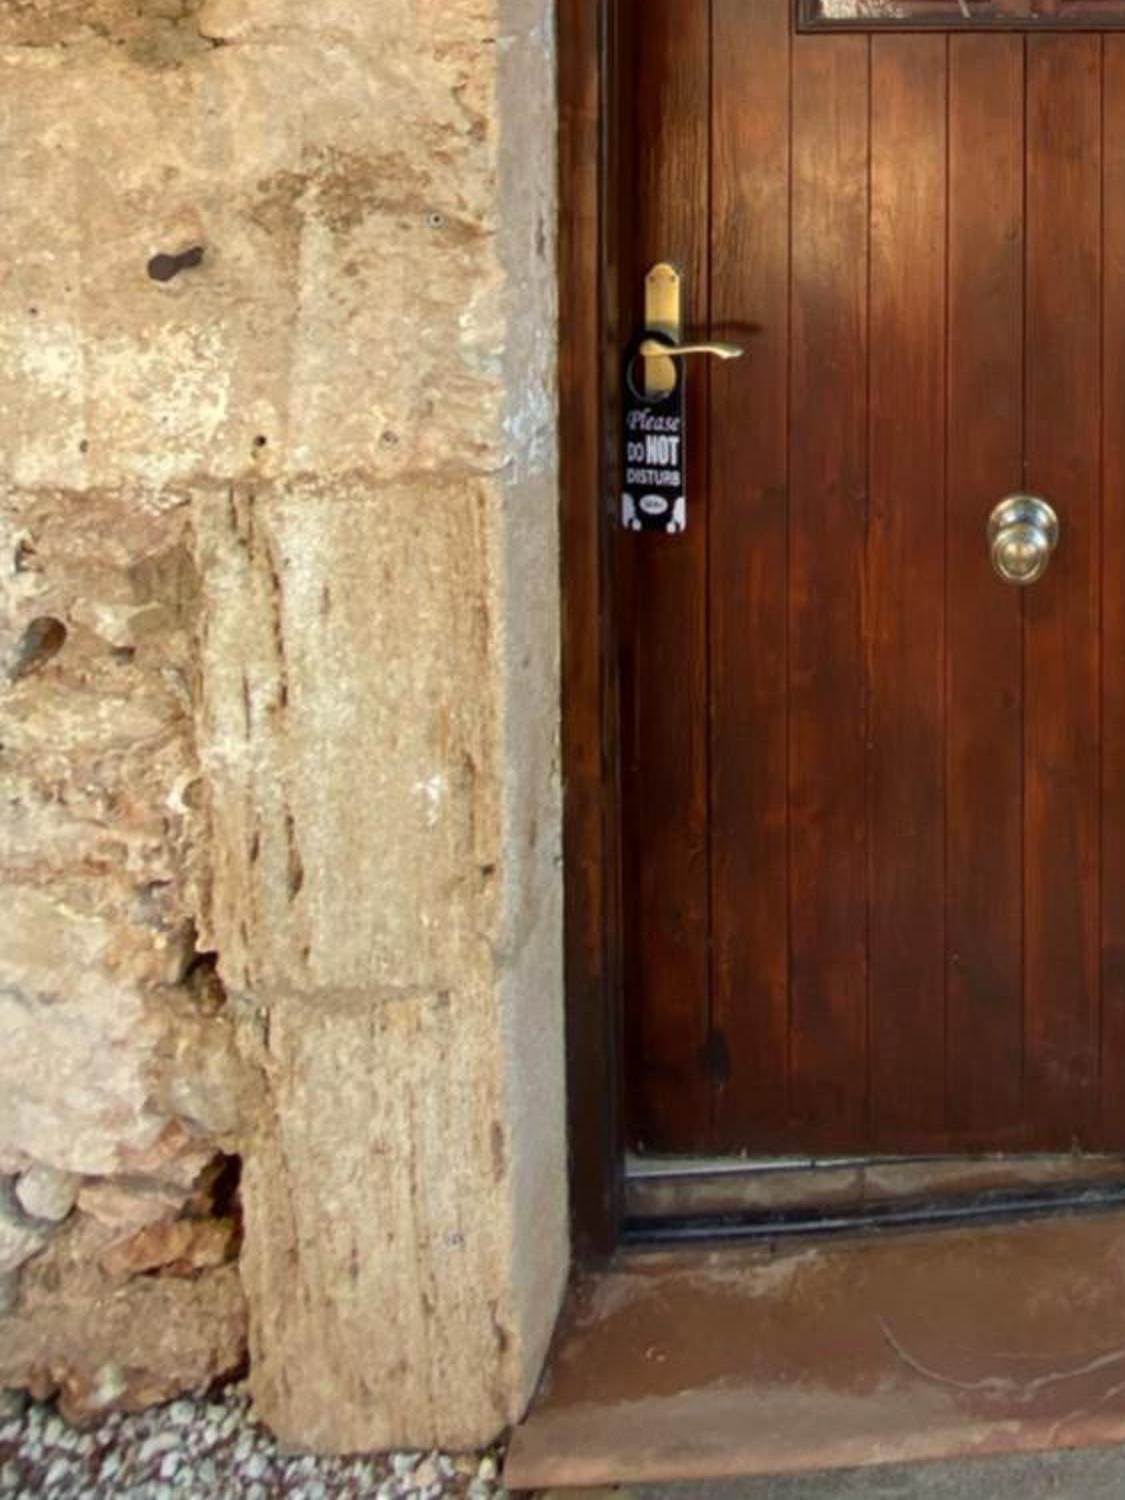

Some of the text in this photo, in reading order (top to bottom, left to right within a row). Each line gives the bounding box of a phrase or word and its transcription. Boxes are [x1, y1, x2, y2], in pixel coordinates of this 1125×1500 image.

[627, 408, 680, 432] Please
[627, 434, 679, 466] DO NOT
[627, 467, 680, 486] DISTURB
